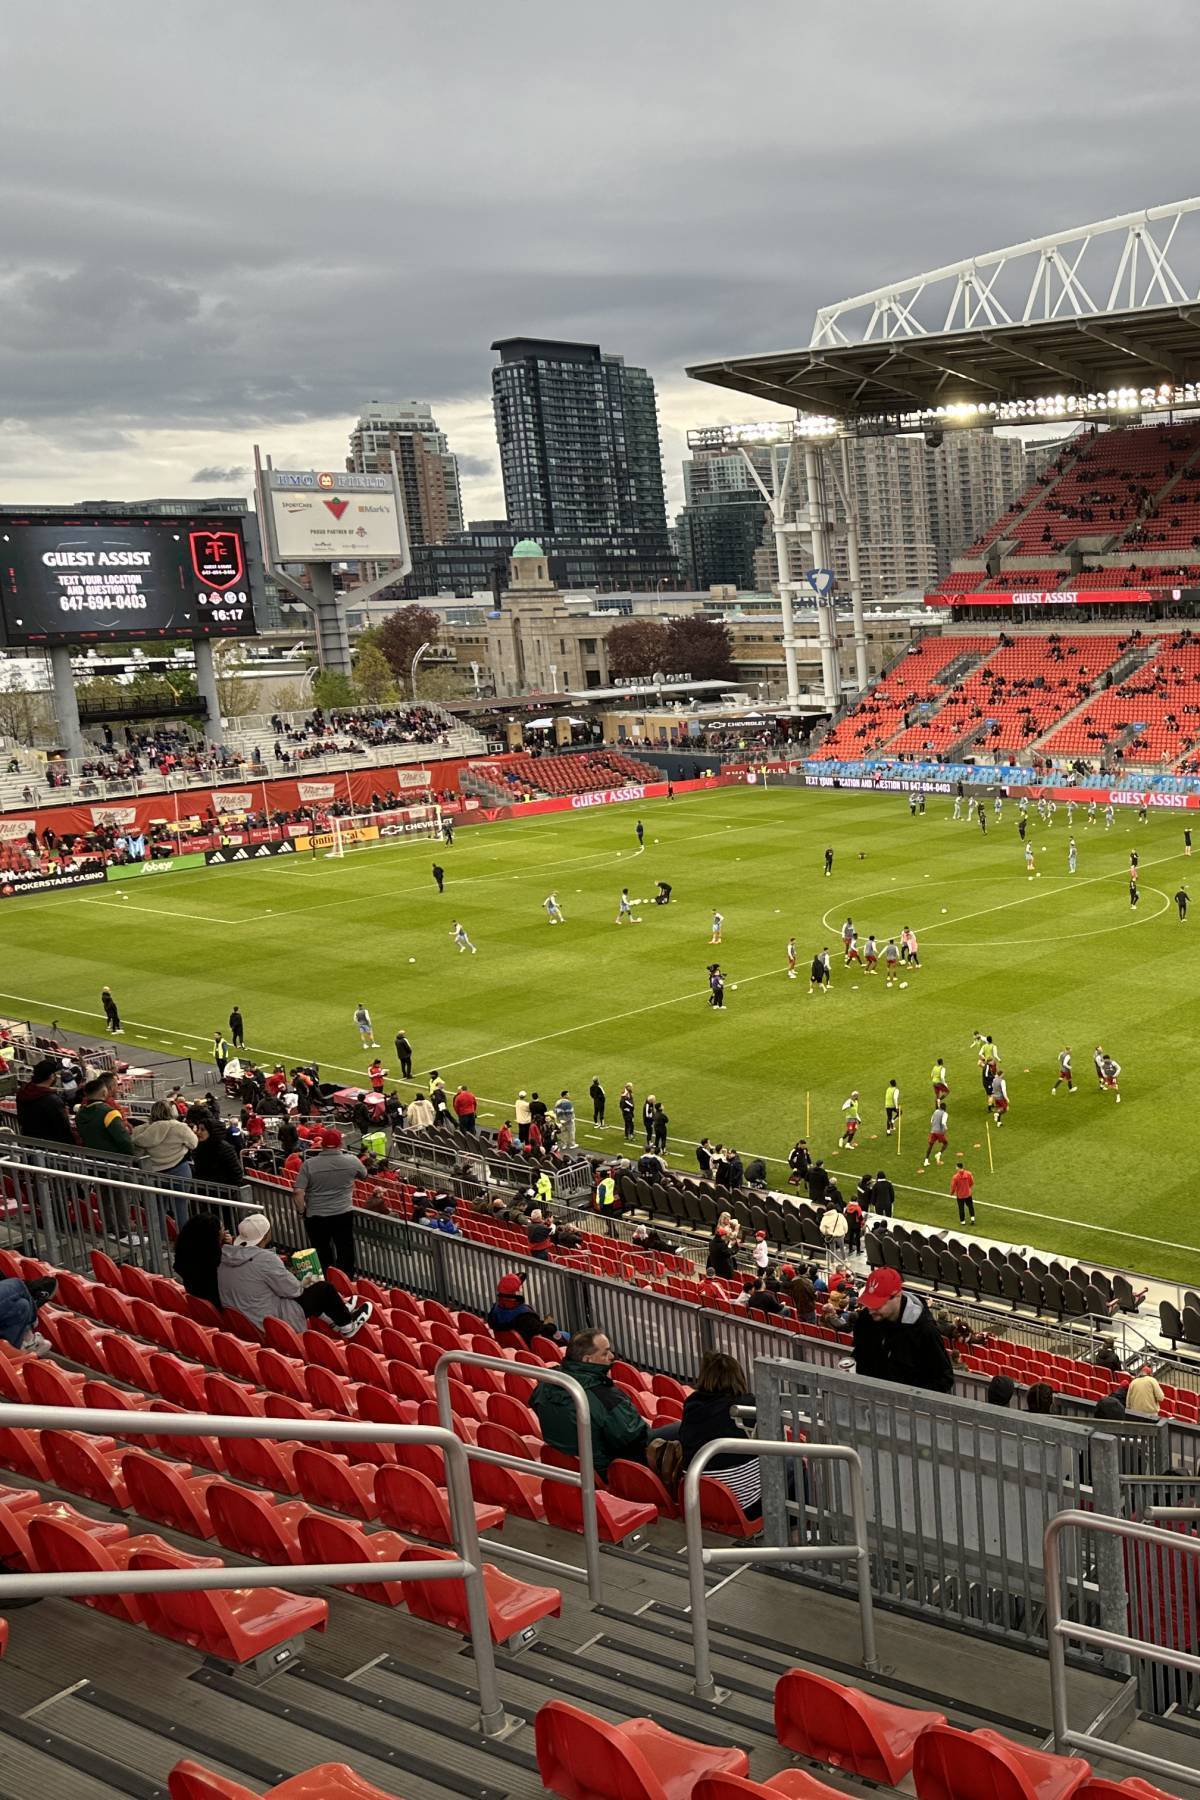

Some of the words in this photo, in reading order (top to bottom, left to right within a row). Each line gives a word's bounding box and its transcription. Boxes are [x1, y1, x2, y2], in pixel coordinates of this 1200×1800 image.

[42, 552, 95, 567] GUEST
[99, 551, 151, 566] ASSIST
[58, 575, 80, 585] TEXT
[81, 575, 104, 585] YOUR
[105, 574, 142, 585] LOCATION
[67, 585, 84, 595] AND
[86, 585, 127, 595] QUESTION
[129, 584, 137, 594] TO
[1012, 592, 1043, 604] GUEST
[1044, 591, 1078, 603] ASSIST
[60, 595, 147, 611] 647-694-0403
[211, 608, 244, 621] 16:17
[805, 776, 819, 785] TEXT
[861, 779, 872, 788] AND
[902, 781, 909, 790] TO
[910, 781, 950, 792] 647-694-0403
[572, 792, 608, 809] GUEST
[608, 787, 647, 803] ASSIST
[1109, 791, 1147, 805] GUEST
[1148, 794, 1189, 807] ASSIST
[14, 876, 73, 892] POKERSTARS
[73, 871, 104, 882] CASINO
